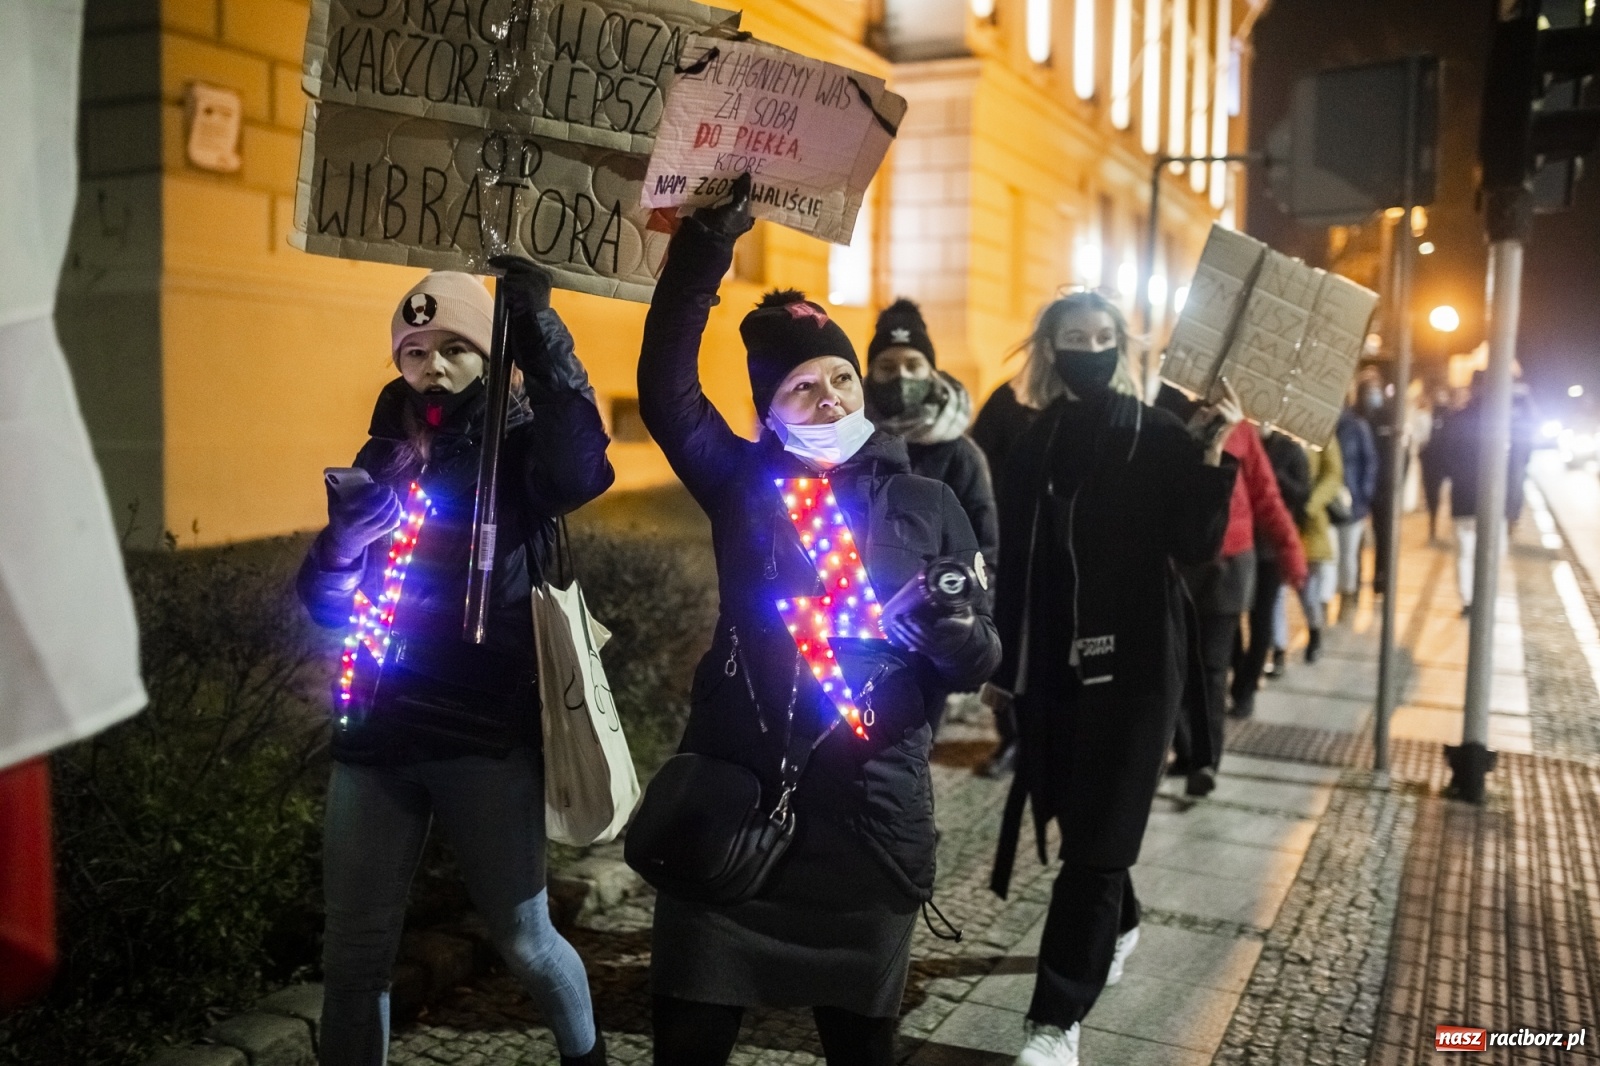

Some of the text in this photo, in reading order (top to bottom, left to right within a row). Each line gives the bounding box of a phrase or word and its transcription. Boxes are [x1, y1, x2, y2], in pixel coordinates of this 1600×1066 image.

[554, 4, 588, 64] W
[596, 11, 704, 83] OCZA
[333, 26, 503, 110] KACZORA
[814, 70, 851, 111] WAS
[714, 90, 800, 134] ZA SOBĄ
[480, 132, 543, 178] OD
[693, 122, 723, 149] DO
[317, 157, 623, 274] WIBRATORA
[654, 174, 823, 218] NAM ZGOTWALIŚCIE
